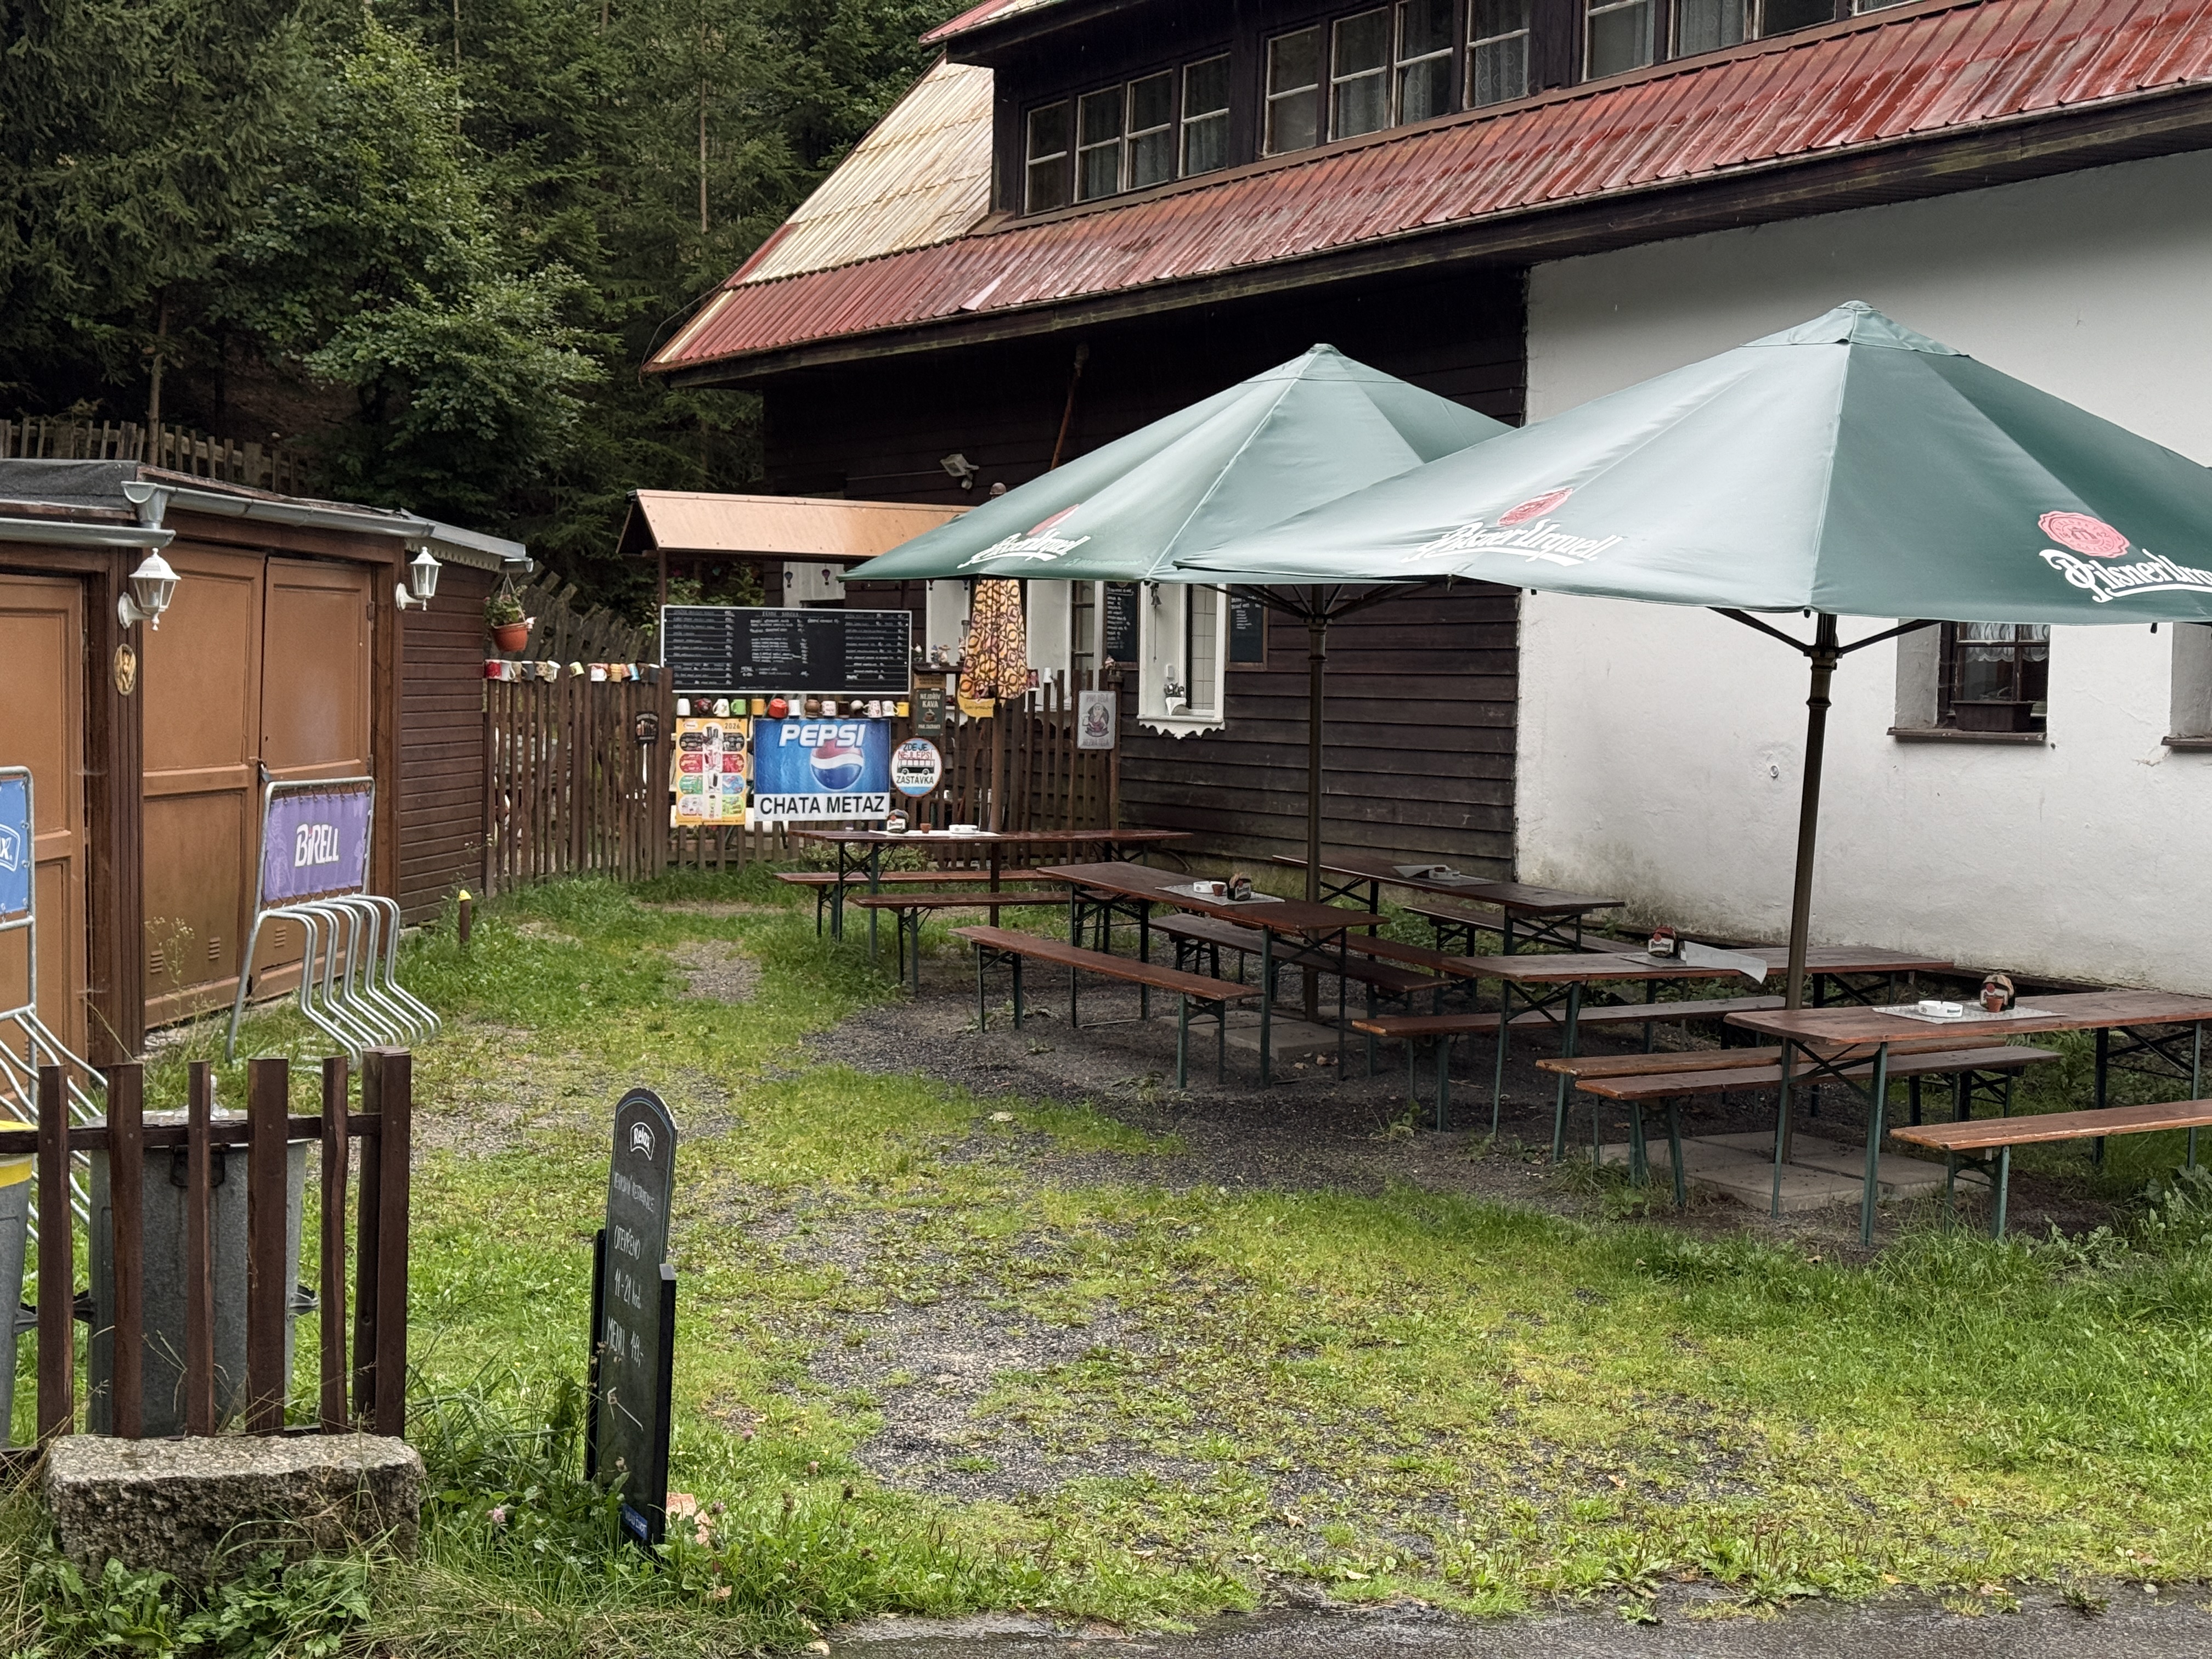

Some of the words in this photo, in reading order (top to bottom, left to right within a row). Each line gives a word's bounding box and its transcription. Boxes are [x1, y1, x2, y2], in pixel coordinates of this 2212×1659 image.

[2039, 549, 2174, 603] Pilsner
[778, 724, 866, 748] PEPSI
[896, 774, 934, 784] ZASTÁVKA
[760, 797, 821, 815] CHATA
[827, 796, 885, 813] METAZ
[606, 1315, 625, 1357] MENU
